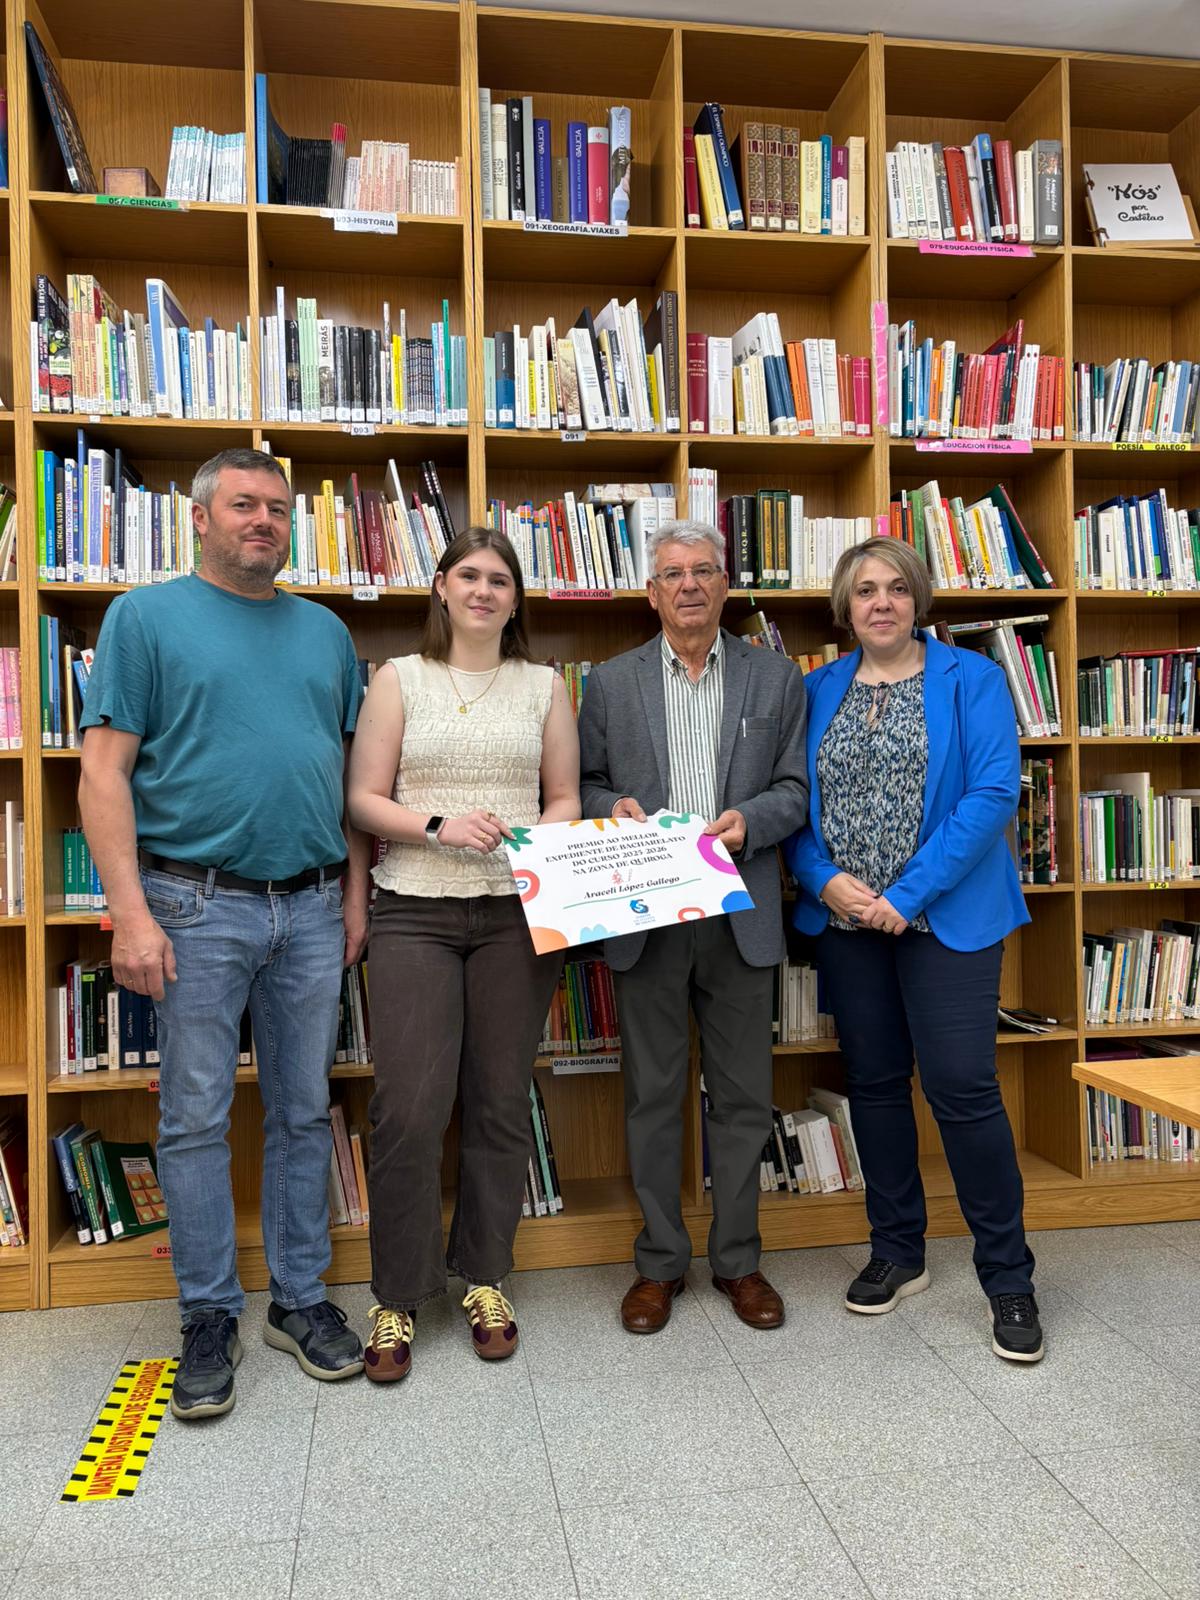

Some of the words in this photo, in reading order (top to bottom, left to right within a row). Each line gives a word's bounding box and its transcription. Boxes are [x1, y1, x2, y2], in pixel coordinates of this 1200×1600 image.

[130, 199, 173, 208] CIENCIAS
[1131, 205, 1149, 214] por
[1118, 211, 1164, 222] Castelao
[37, 278, 45, 304] BRYSON
[38, 305, 46, 318] BILL
[320, 325, 329, 358] MEIRÁS
[1116, 442, 1144, 451] POESÍA
[1155, 443, 1187, 451] GALEGO
[56, 492, 64, 524] ILUSTRADA
[56, 525, 64, 550] CIENCIA
[358, 591, 373, 599] 093
[1156, 735, 1169, 743] P-G
[545, 848, 605, 864] EXPEDIENTE
[605, 845, 619, 854] DE
[619, 835, 686, 851] BACHARELATO
[567, 839, 605, 851] PREMIO
[606, 837, 619, 845] AO
[621, 832, 659, 843] MELLOR
[572, 860, 587, 868] DO
[588, 853, 620, 865] CURSO
[572, 868, 588, 877] NA
[588, 863, 615, 874] ZONA
[616, 860, 630, 869] DE
[630, 853, 673, 867] QUIROGA
[584, 886, 617, 900] Araceli
[619, 884, 644, 893] López
[646, 876, 680, 888] Gallego
[553, 1057, 619, 1067] 092-BIOGRAFÍAS
[128, 1361, 168, 1403] SEGURIDADE
[123, 1402, 149, 1413] DE
[105, 1409, 146, 1454] DISTANCIA
